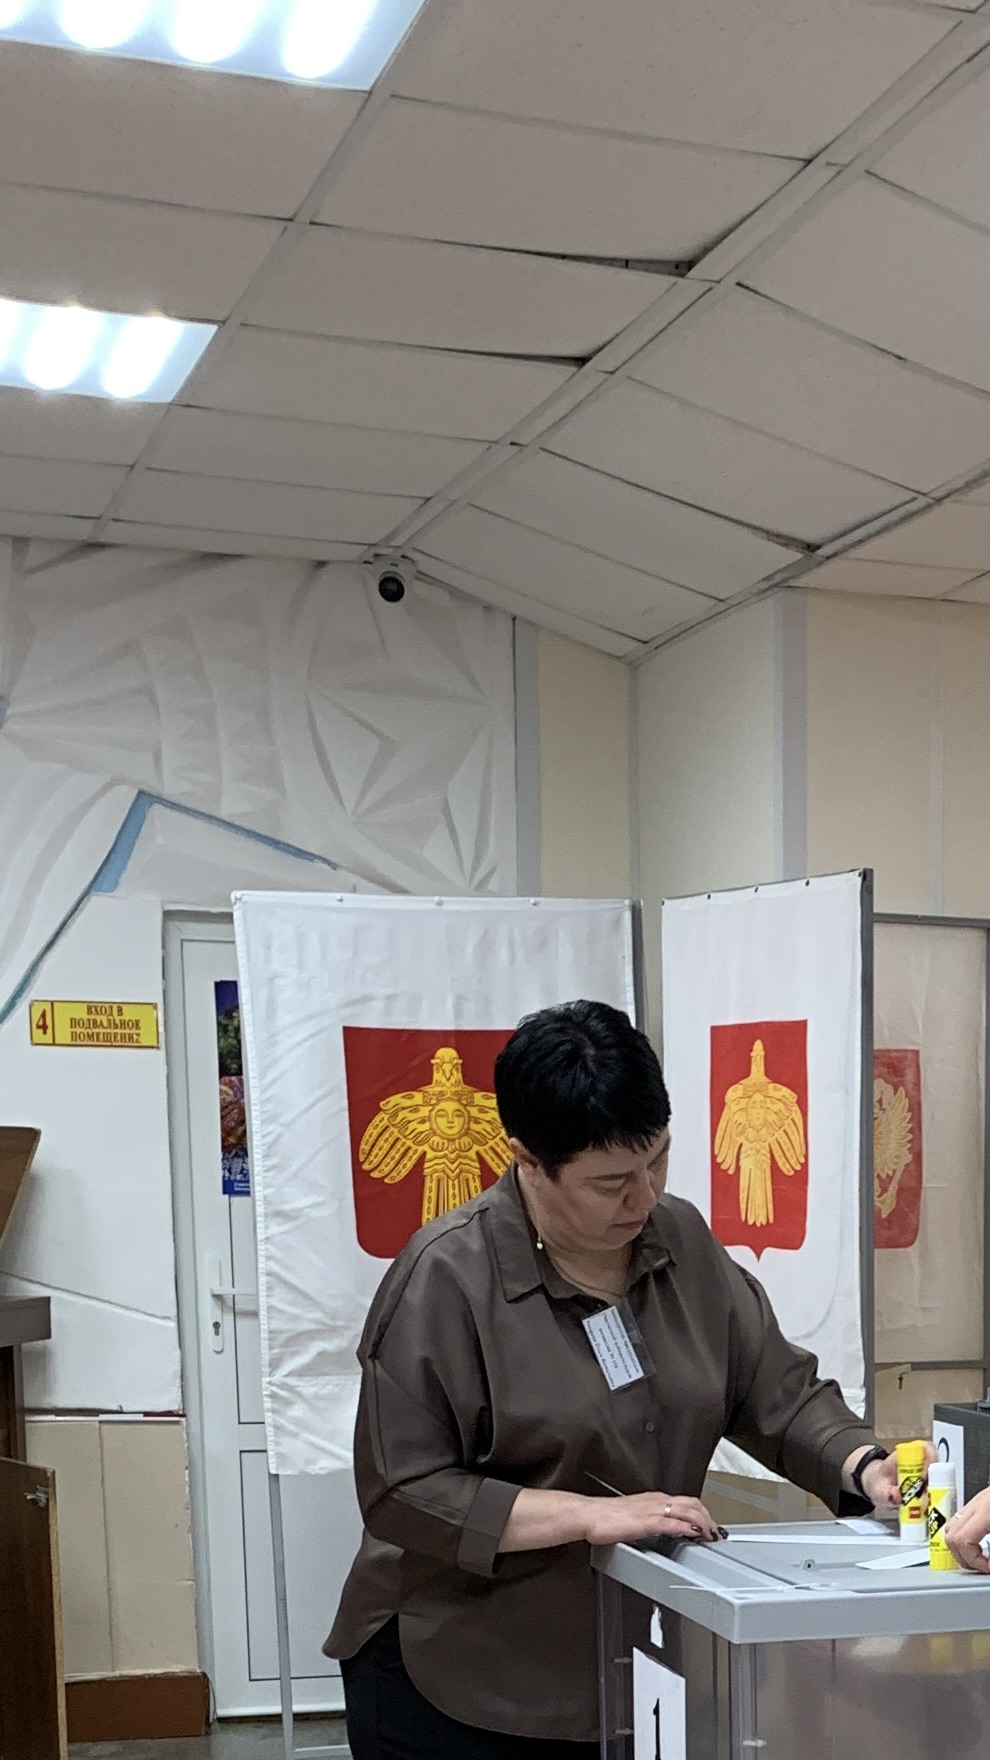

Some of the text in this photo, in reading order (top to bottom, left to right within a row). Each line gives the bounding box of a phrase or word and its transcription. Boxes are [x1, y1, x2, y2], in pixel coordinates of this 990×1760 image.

[86, 1005, 124, 1018] ВХОД В
[36, 1008, 49, 1035] 4
[69, 1017, 142, 1031] ПОДВАЛЬНОЕ
